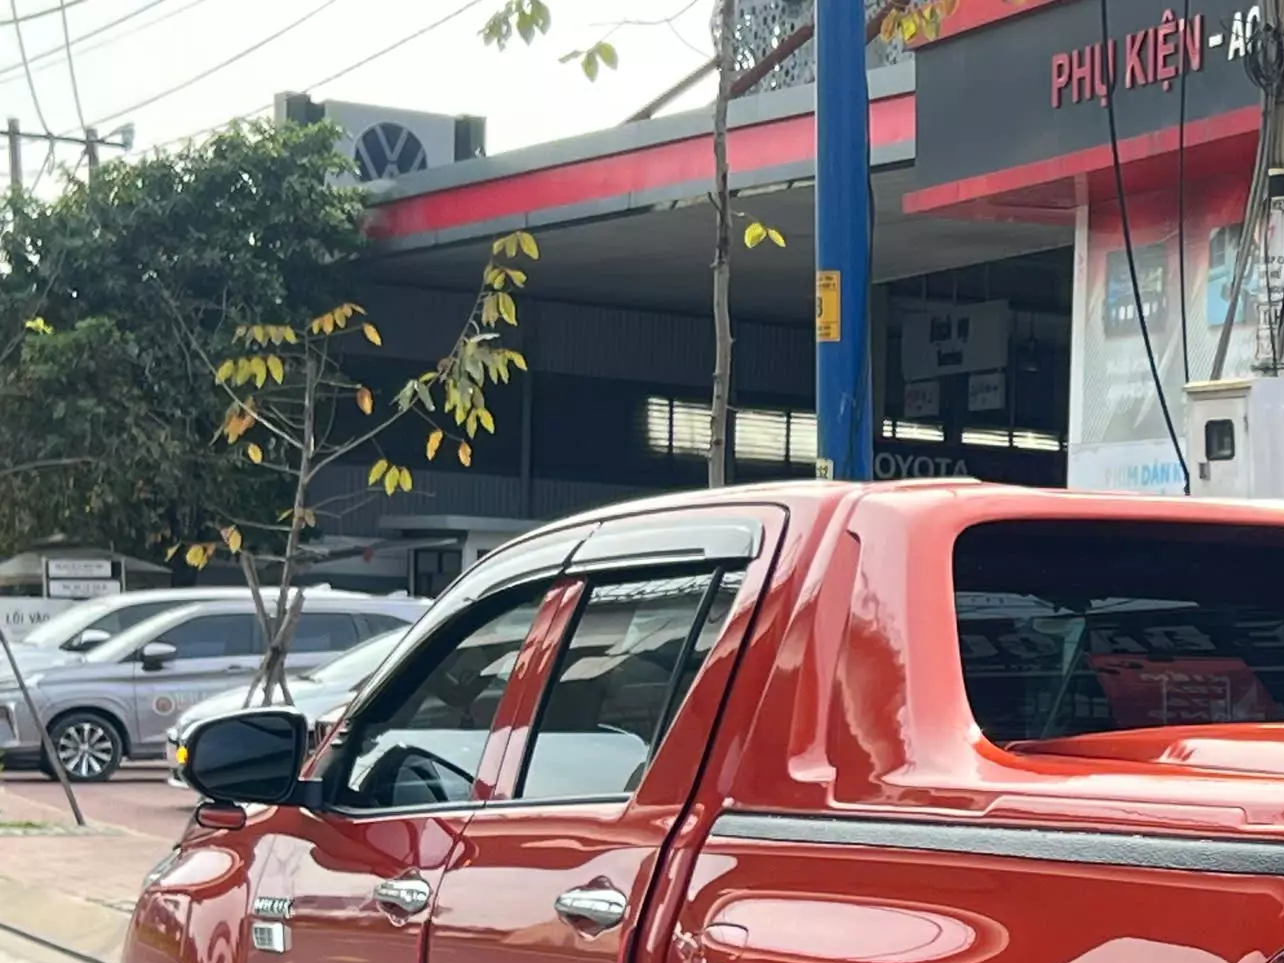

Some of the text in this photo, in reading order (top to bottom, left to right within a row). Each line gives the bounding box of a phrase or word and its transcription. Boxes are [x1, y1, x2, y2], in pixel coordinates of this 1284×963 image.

[1051, 37, 1116, 109] PHỤ
[1124, 8, 1203, 92] KIỆN
[875, 451, 968, 478] OYOTA
